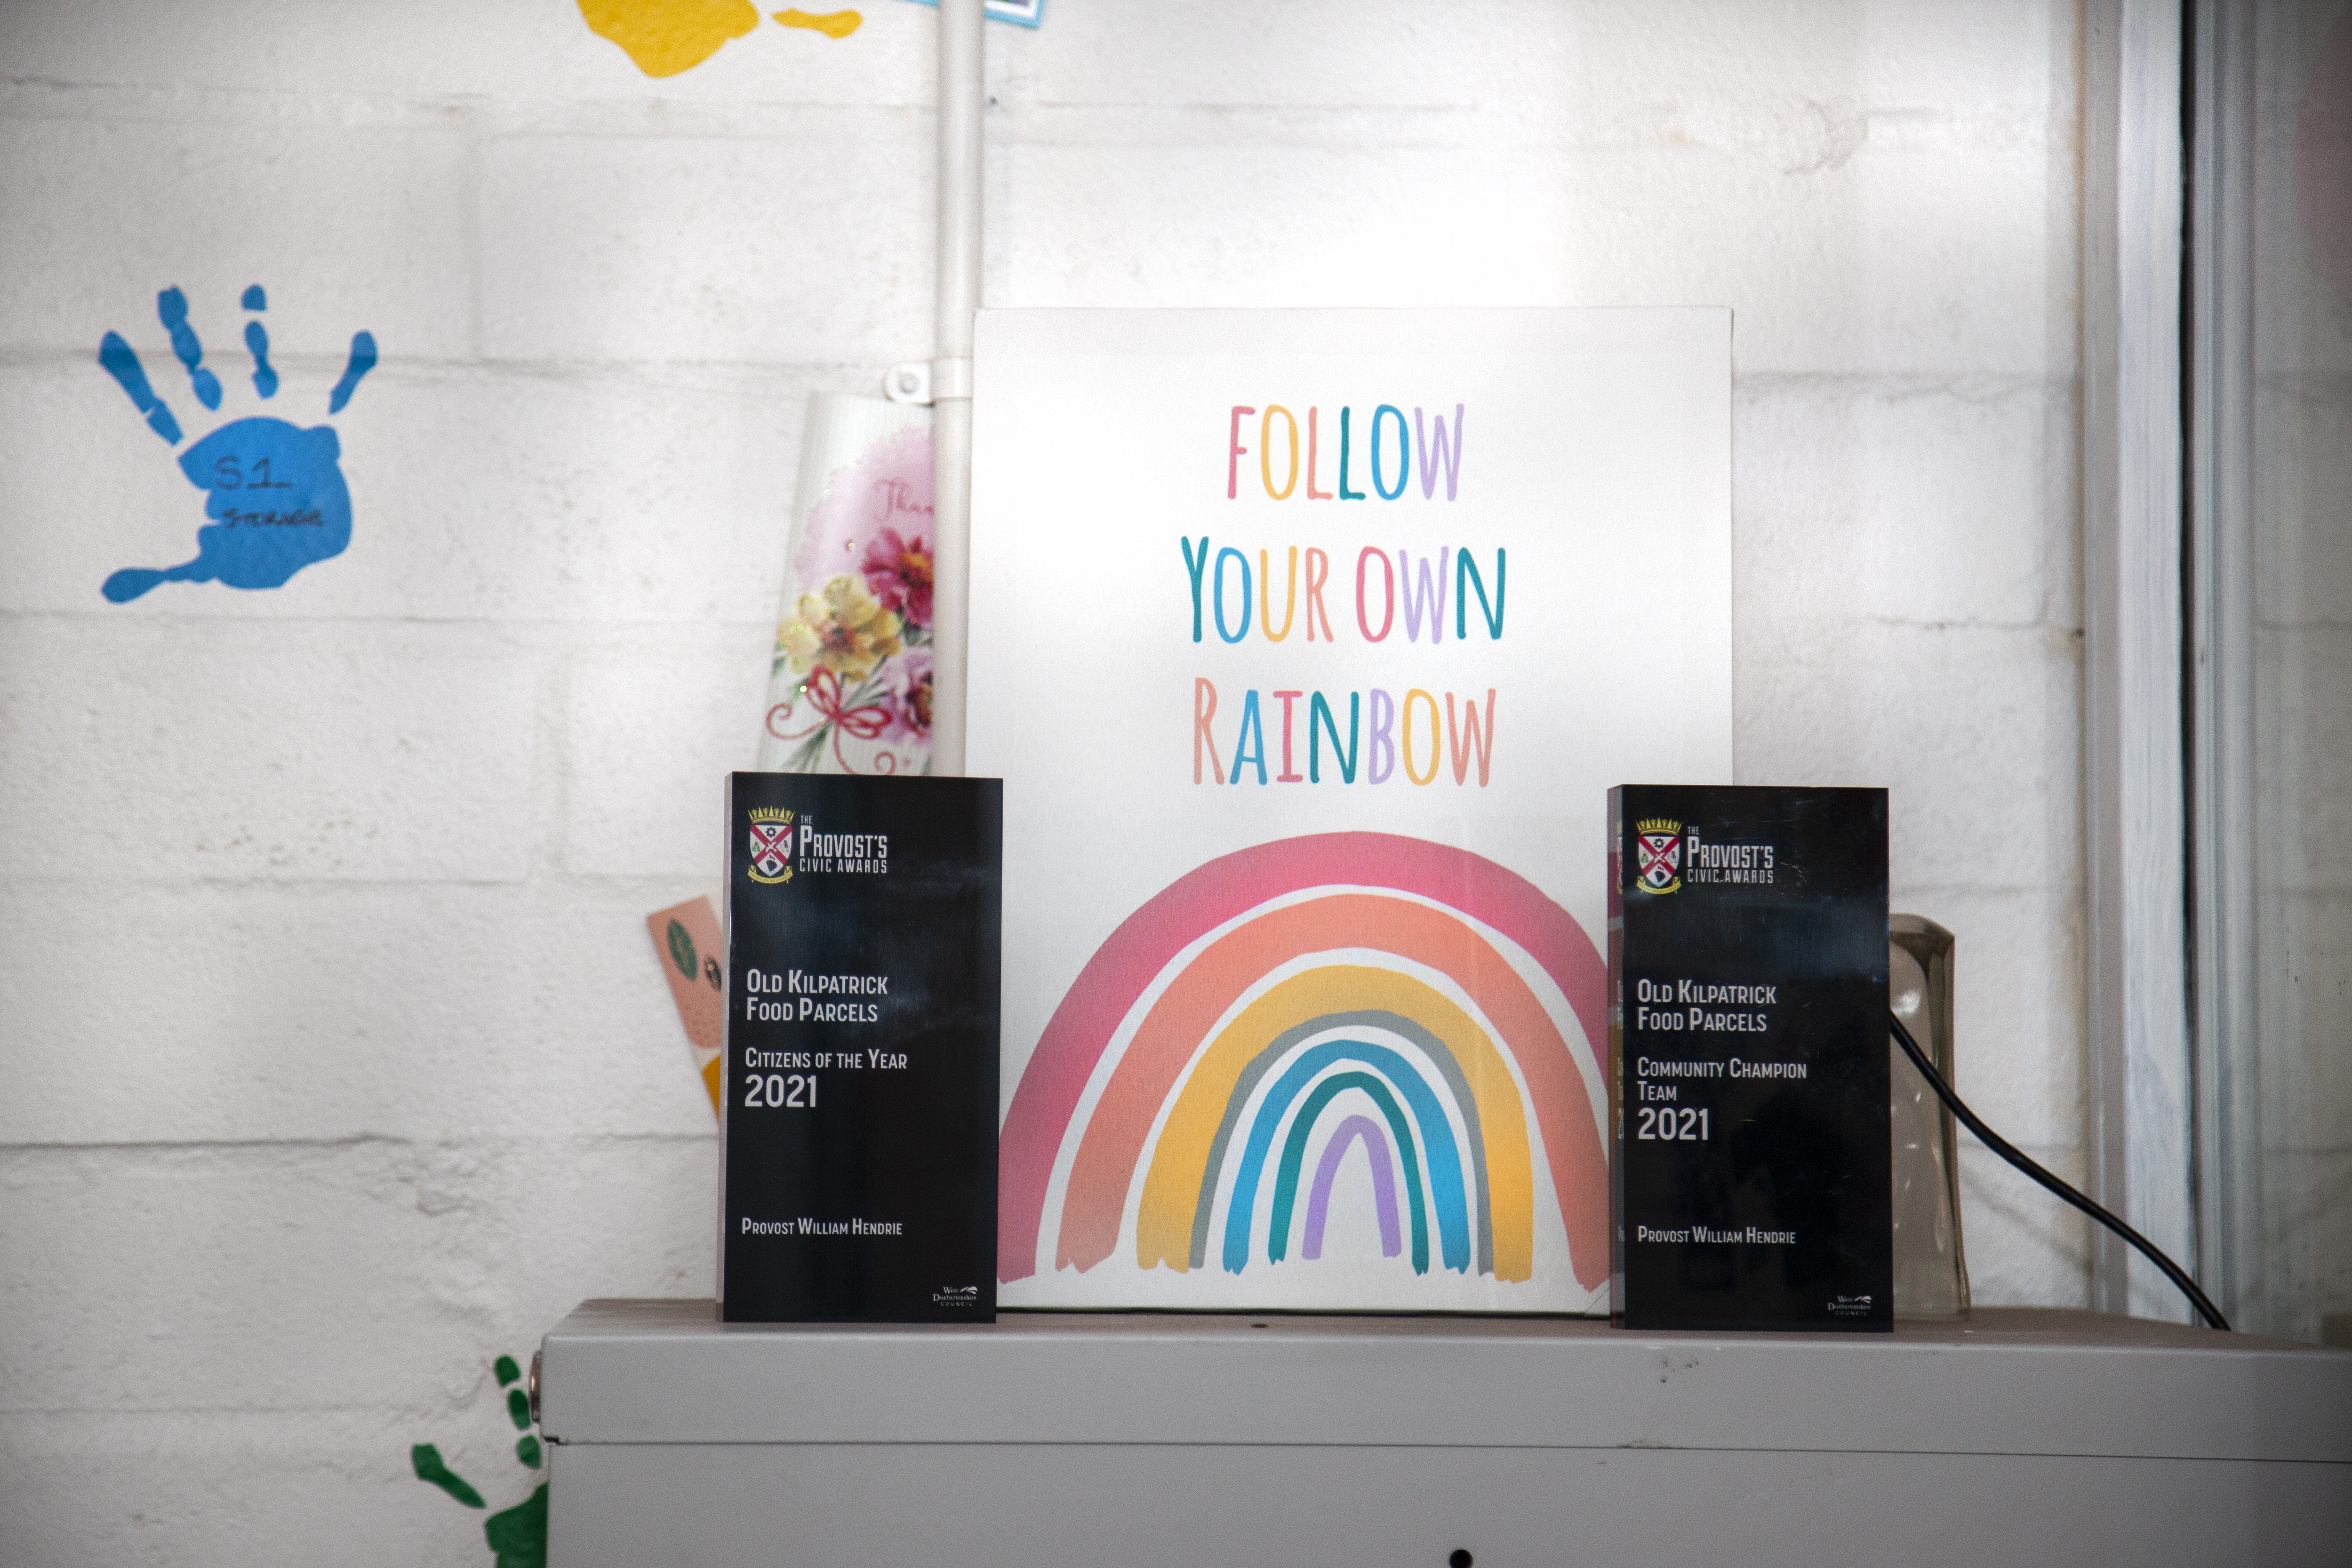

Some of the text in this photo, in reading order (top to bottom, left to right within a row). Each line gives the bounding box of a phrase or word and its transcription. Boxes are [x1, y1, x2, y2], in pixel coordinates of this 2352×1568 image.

[1227, 404, 1464, 501] FOLLOW
[874, 477, 934, 520] Than
[1180, 536, 1506, 644] YOUR OWN
[1193, 676, 1496, 787] RAINBOW
[800, 825, 887, 859] PROVOST'S
[1687, 836, 1773, 868] PROVOST'S
[800, 859, 887, 873] CIVIC AWARDS
[1688, 869, 1773, 883] CIVIC AWARDS
[747, 969, 888, 995] OLD KILPATRICK
[1638, 979, 1672, 1003] OLD
[1679, 980, 1776, 1004] KILPATRICK
[747, 997, 877, 1022] FOOD PARCELS
[1638, 1007, 1683, 1030] FOOD
[1690, 1008, 1767, 1032] PARCELS
[745, 1047, 907, 1069] CITIZENS OF THE YEAR
[1638, 1057, 1724, 1077] COMMUNITY
[1730, 1058, 1806, 1078] CHAMPION
[745, 1075, 816, 1107] 2021
[1638, 1081, 1676, 1101] TEAM
[1638, 1108, 1708, 1140] 2021
[742, 1218, 902, 1235] PROVOST WILLIAM HENDRIE
[1638, 1226, 1689, 1242] PROVOST
[1692, 1227, 1742, 1243] WILLIAM
[1747, 1227, 1795, 1243] HENDRIE
